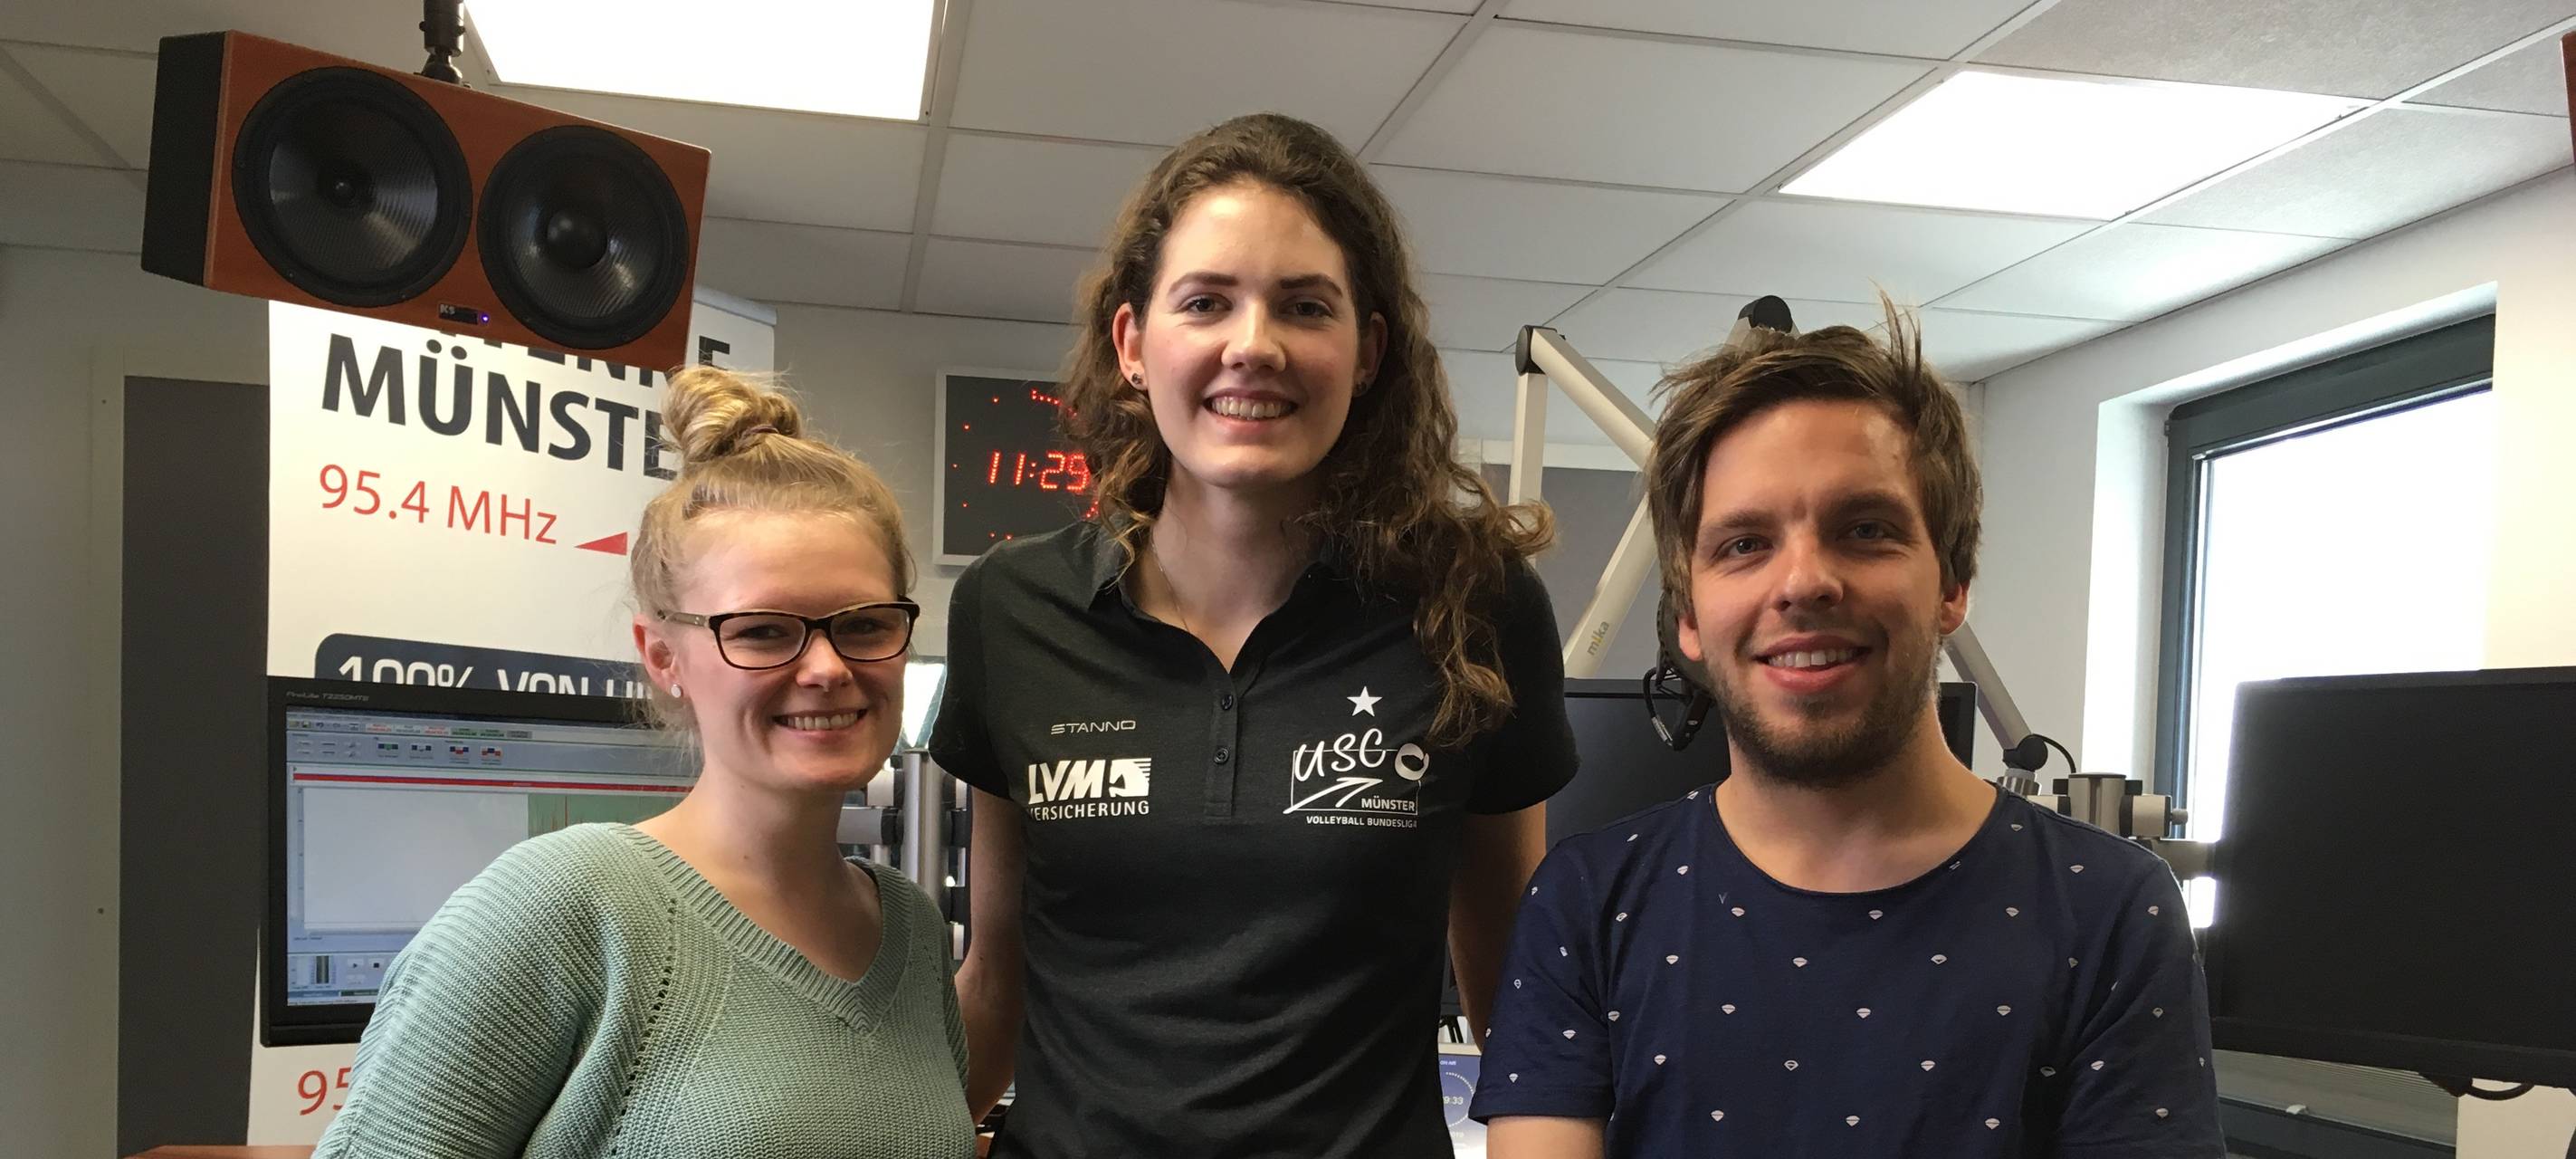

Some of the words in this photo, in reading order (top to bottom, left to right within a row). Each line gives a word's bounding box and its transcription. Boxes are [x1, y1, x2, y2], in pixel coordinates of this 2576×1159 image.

[321, 332, 679, 481] MÜNSTE
[988, 451, 1091, 492] 11:29
[320, 464, 430, 523] 95.4
[447, 485, 558, 545] MHz
[1587, 621, 1609, 656] mika
[1051, 720, 1137, 735] STANNO
[1295, 728, 1386, 781] USC
[1028, 760, 1106, 804] LVM
[1306, 816, 1364, 826] VOLLEYBALL
[1361, 795, 1415, 812] MÜNSTER
